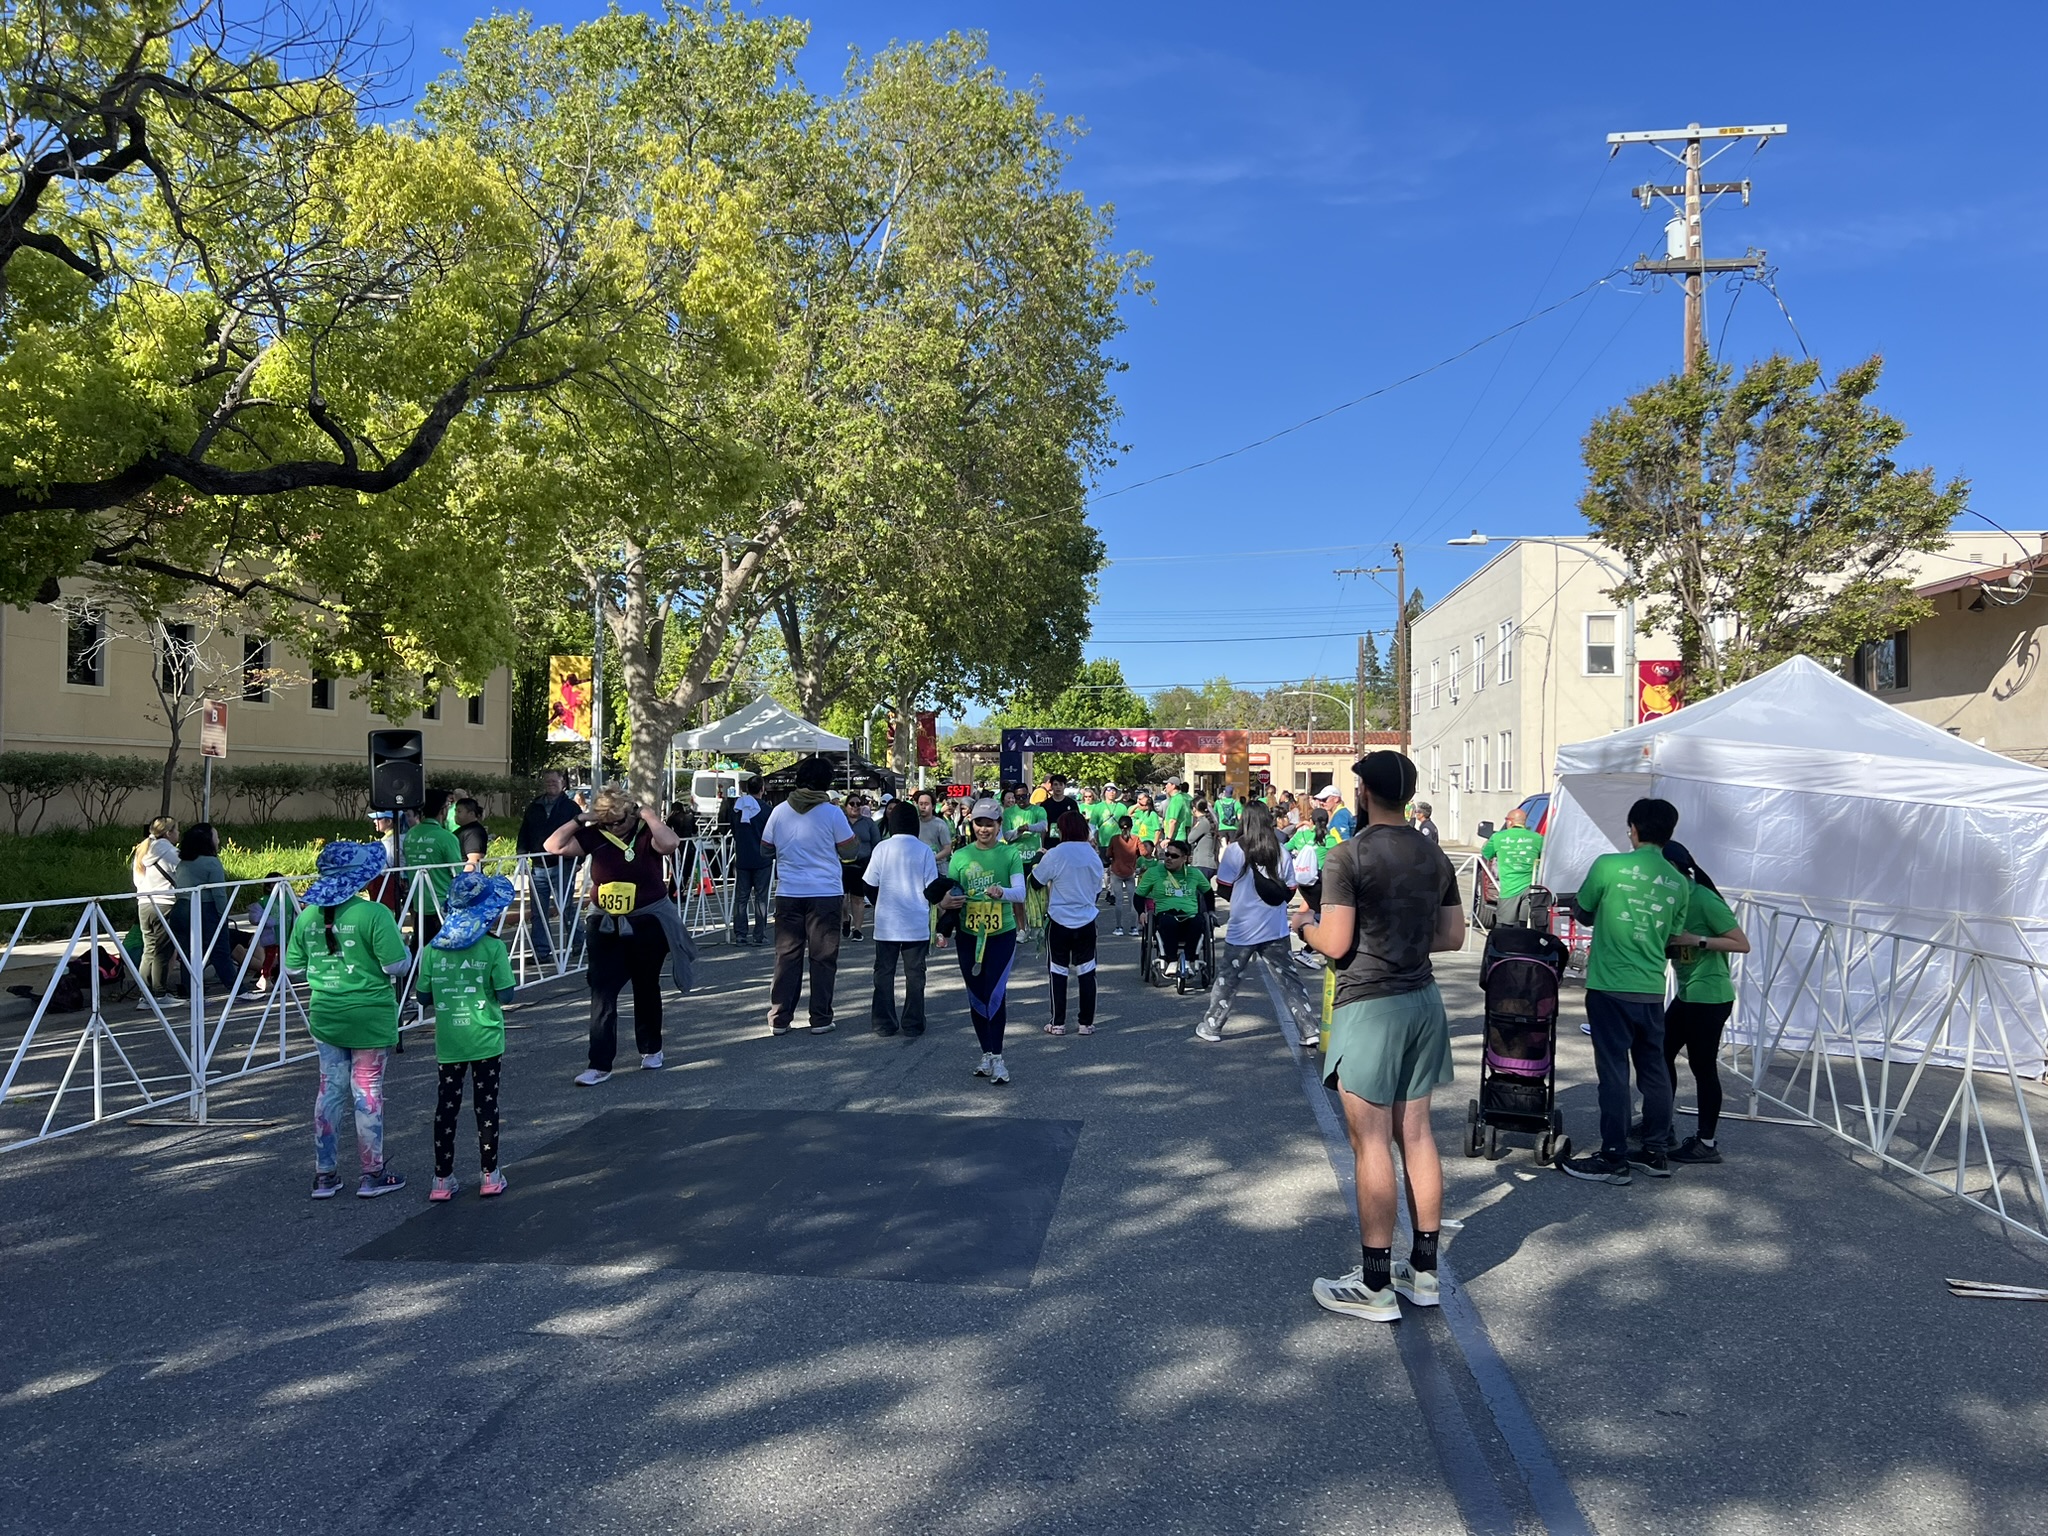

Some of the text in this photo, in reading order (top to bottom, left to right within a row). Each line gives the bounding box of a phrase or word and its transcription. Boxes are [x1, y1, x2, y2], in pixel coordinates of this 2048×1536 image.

[212, 709, 218, 722] B
[1035, 734, 1053, 744] Lam
[1072, 735, 1173, 747] Heart & Soles Run
[968, 874, 995, 889] HEART
[600, 894, 631, 911] 3351
